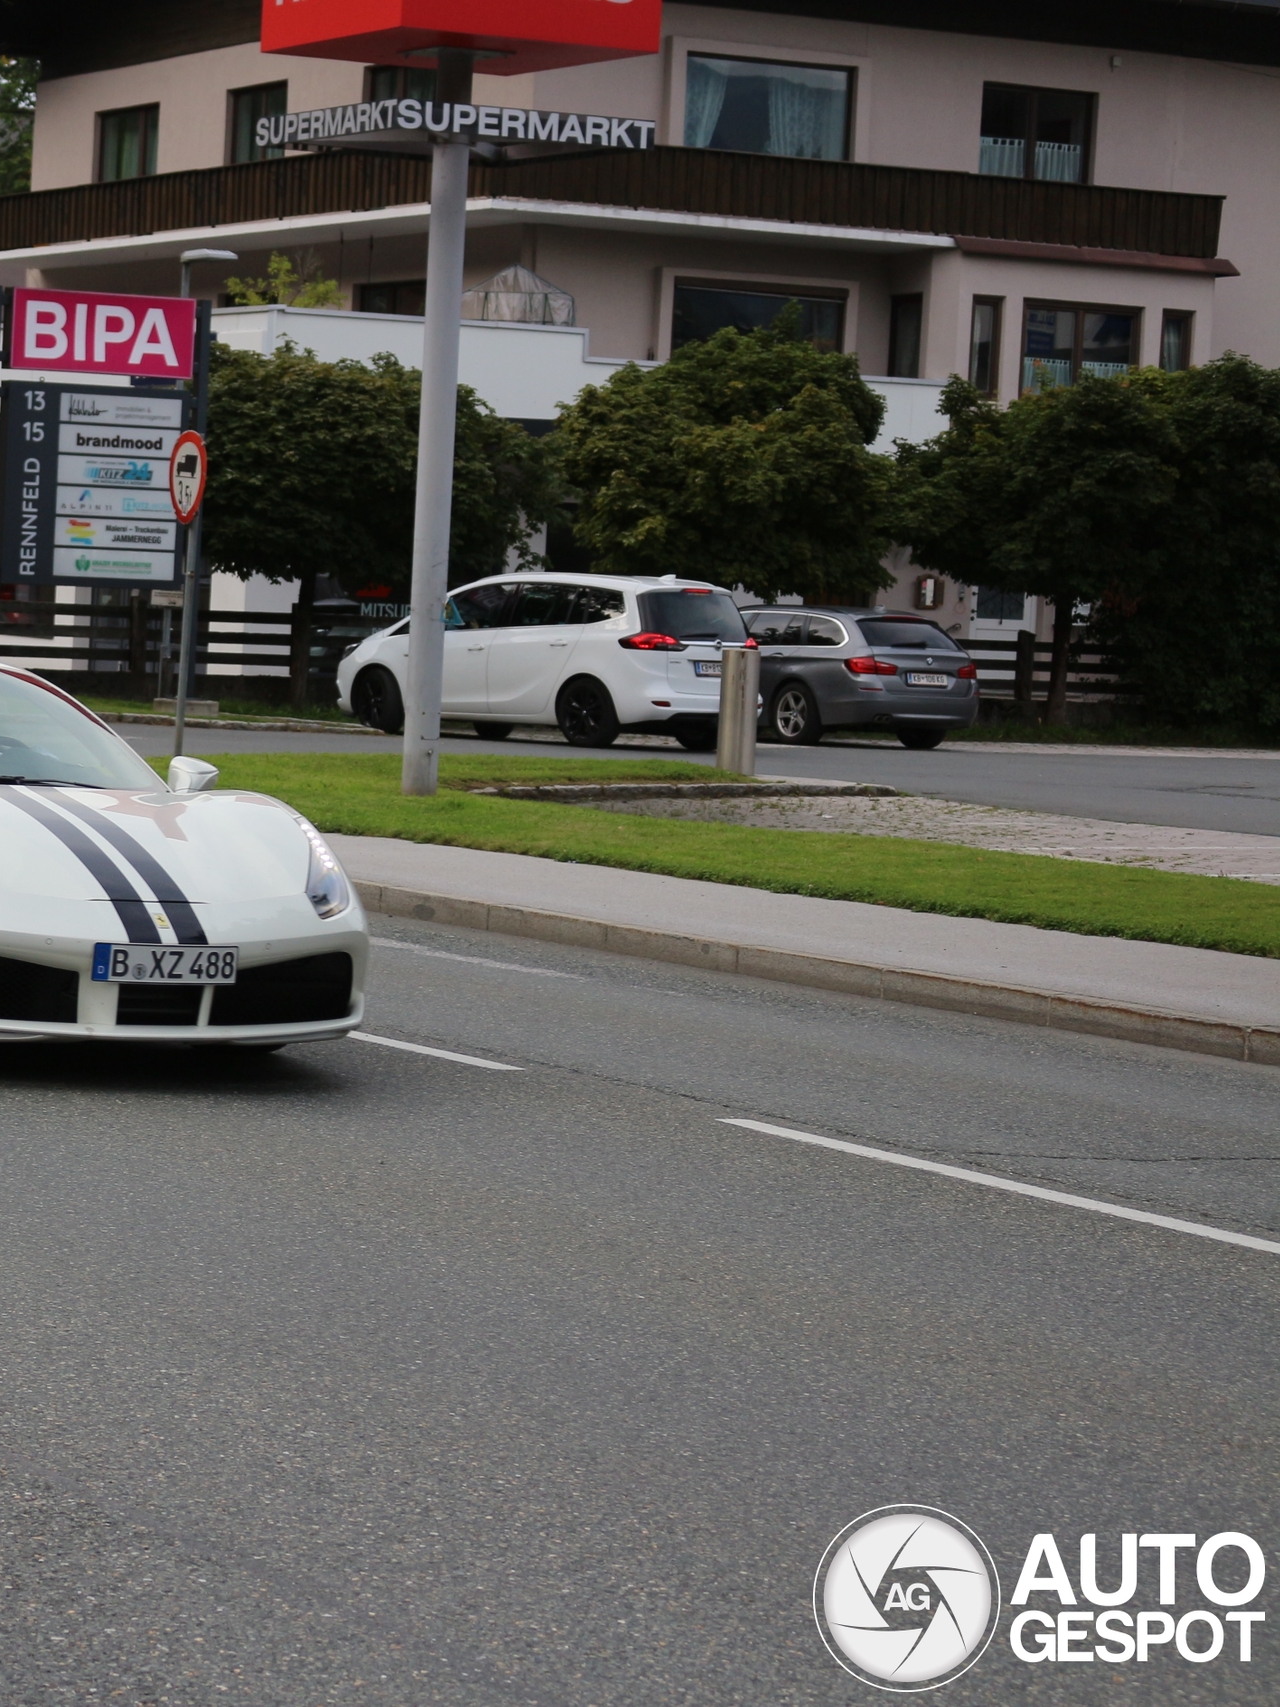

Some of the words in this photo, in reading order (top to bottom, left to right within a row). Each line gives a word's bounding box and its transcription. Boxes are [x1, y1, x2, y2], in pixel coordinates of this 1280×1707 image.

[255, 99, 398, 147] SUPERMARKT
[397, 99, 656, 150] SUPERMARKT
[24, 300, 179, 367] BIPA
[24, 390, 46, 411] 13
[22, 421, 45, 442] 15
[76, 432, 163, 451] brandmood
[99, 468, 124, 479] KITZ
[124, 461, 150, 480] 24
[19, 457, 41, 576] RENNFELD
[60, 503, 101, 511] ALPIN
[105, 524, 128, 533] Malerei
[134, 525, 169, 534] Trockenbau
[111, 535, 162, 544] JAMMERNEGG
[111, 949, 129, 977] B
[149, 950, 184, 979] XZ
[189, 951, 235, 979] 488
